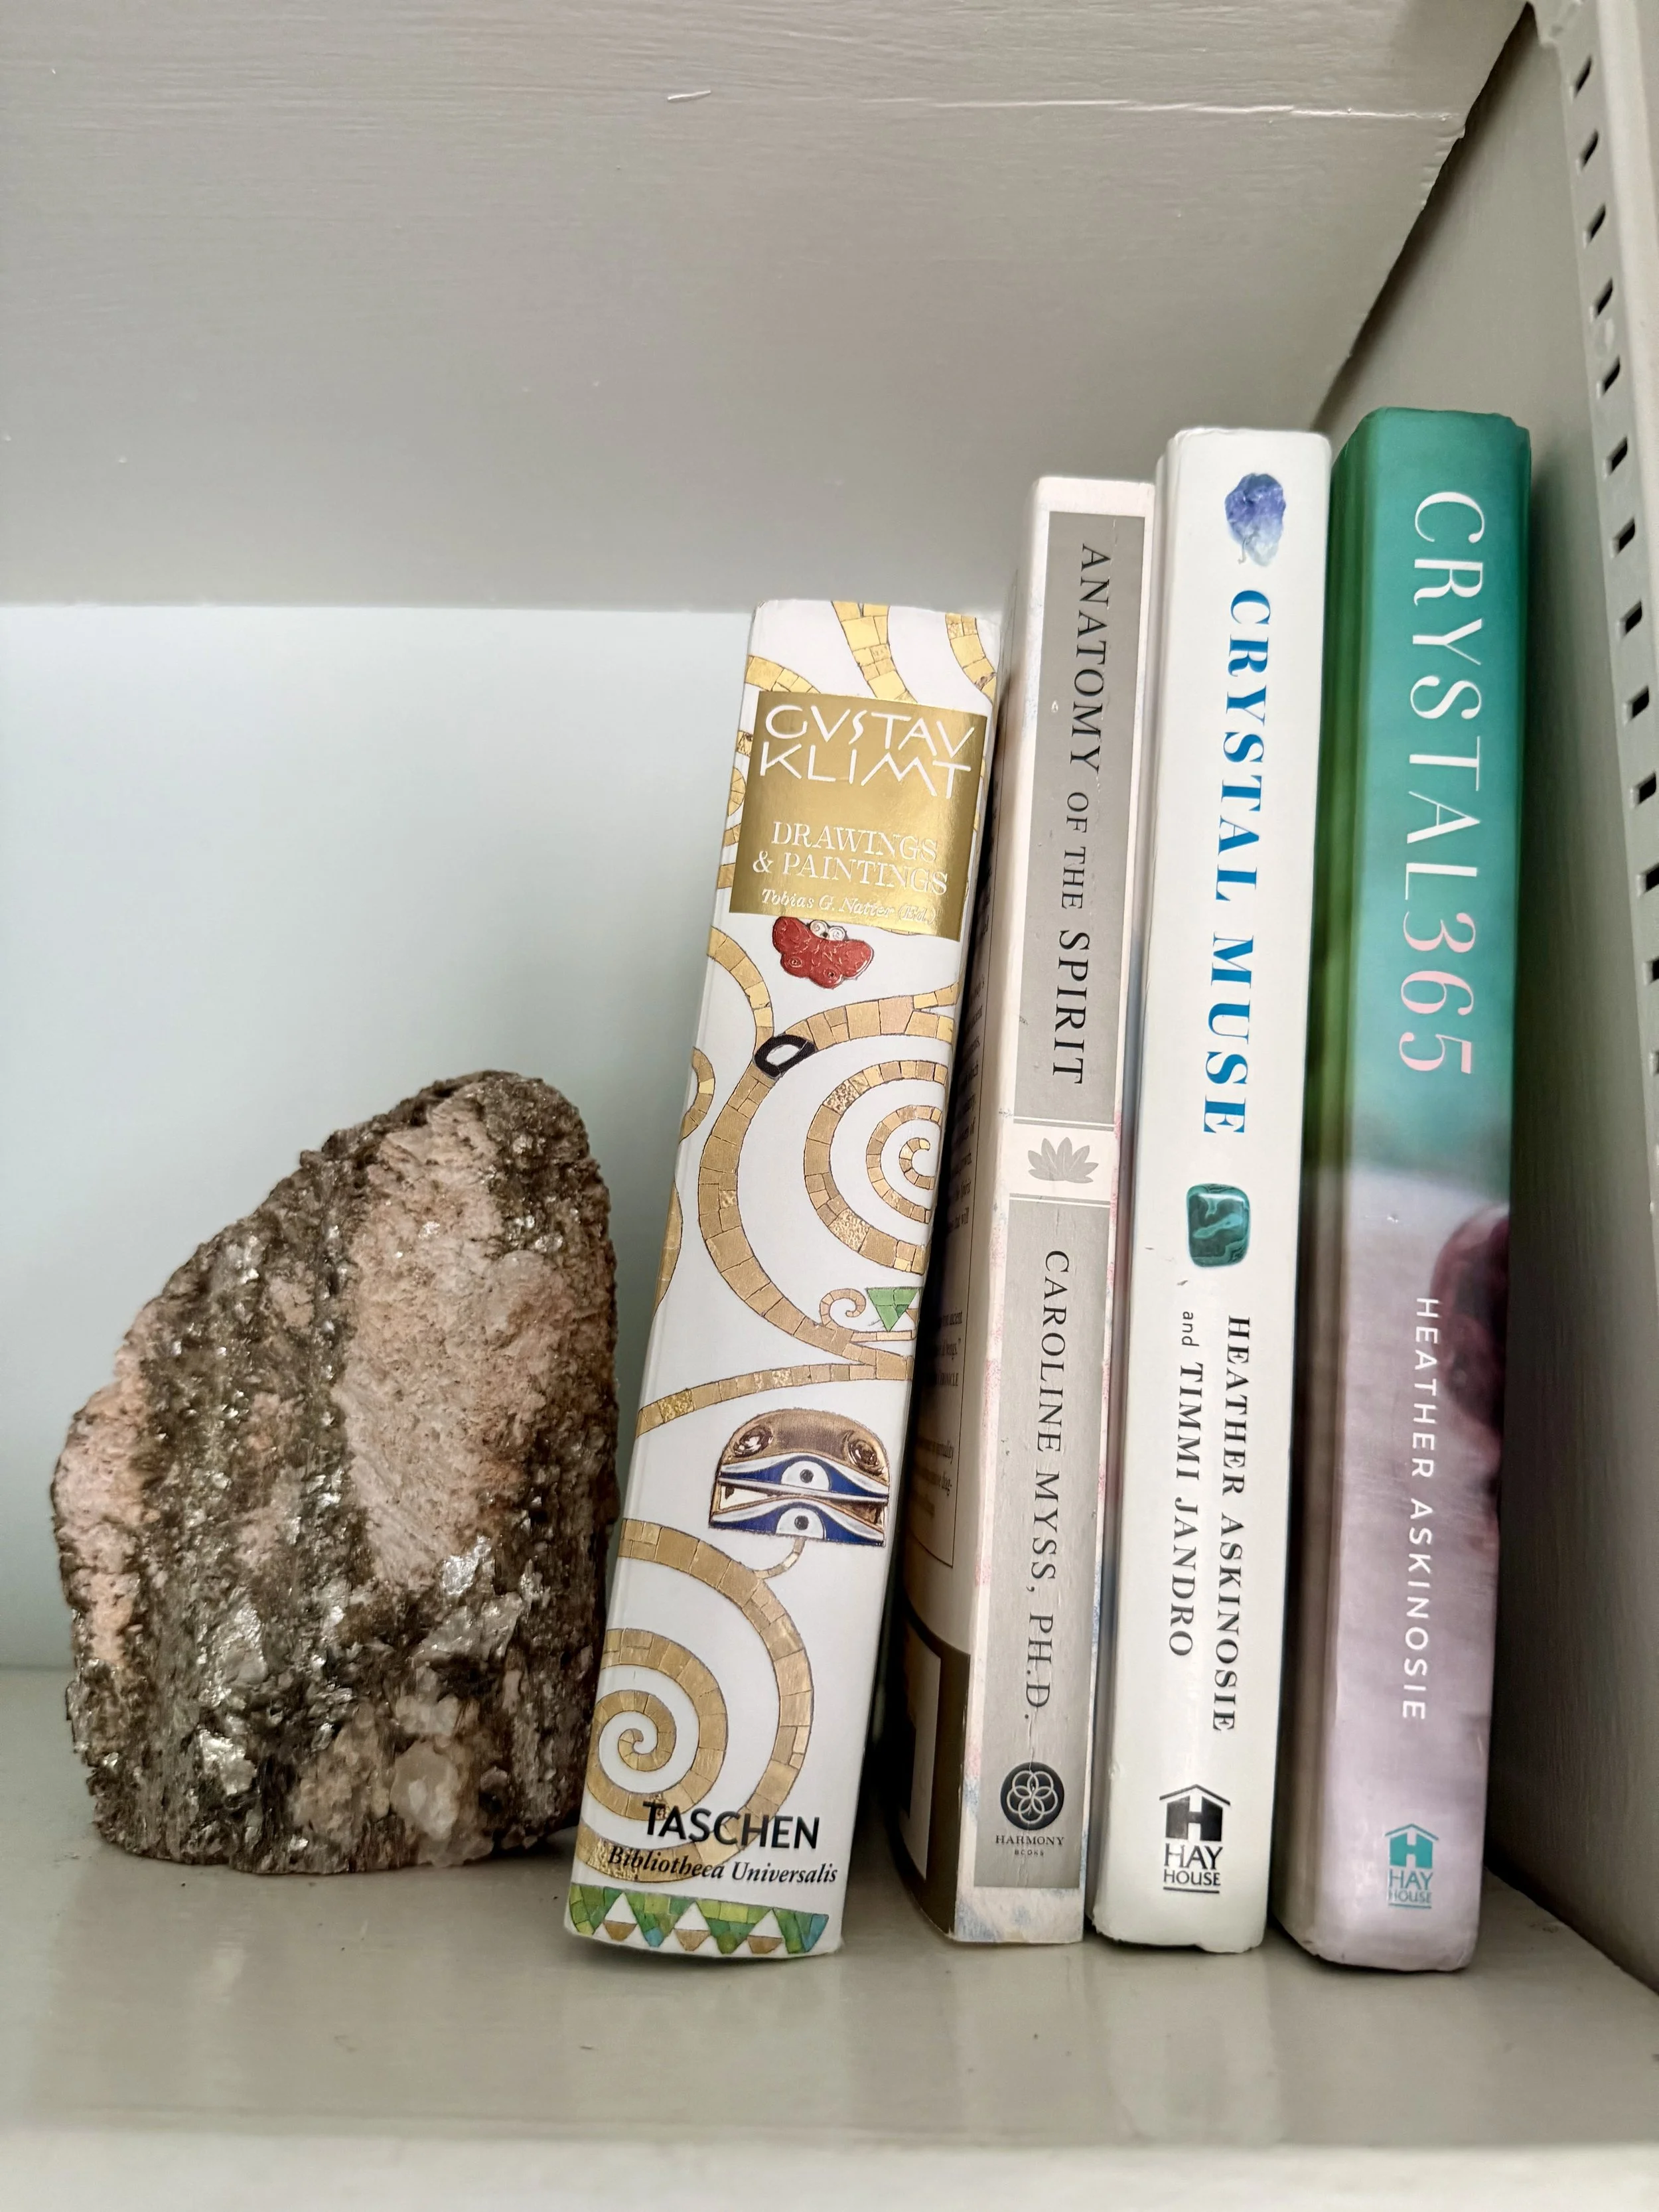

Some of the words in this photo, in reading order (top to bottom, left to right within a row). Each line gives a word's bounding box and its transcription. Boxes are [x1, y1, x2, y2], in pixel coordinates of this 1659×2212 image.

[1070, 543, 1112, 774] ANATOMY
[760, 741, 971, 799] KLIMT
[1215, 589, 1271, 902] CRYSTAL
[772, 821, 938, 862] DRAWINGS
[1066, 791, 1090, 834] OF
[753, 850, 773, 873] &
[782, 852, 948, 895] PAINTINGS
[1061, 846, 1086, 910] THE
[762, 888, 814, 909] Tobias
[819, 894, 835, 913] G.
[838, 897, 896, 919] Natter
[1052, 930, 1090, 1085] SPIRIT
[1203, 932, 1254, 1134] MUSE
[1037, 1250, 1070, 1452] CAROLINE
[1181, 1311, 1200, 1347] and
[1222, 1315, 1250, 1496] HEATHER
[1411, 1297, 1439, 1479] HEATHER
[1176, 1362, 1204, 1481] TIMMI
[1026, 1470, 1060, 1593] MYSS,
[1169, 1497, 1198, 1656] JANDRO
[1212, 1511, 1244, 1732] ASKINOSIE
[1402, 1498, 1434, 1720] ASKINOSIE
[642, 1801, 820, 1850] TASCHEN
[995, 1834, 1065, 1846] HARMONY
[609, 1845, 724, 1880] Bibliotheca
[731, 1862, 838, 1883] Universalis
[1163, 1868, 1222, 1886] HOUSE
[1164, 1843, 1223, 1870] HAY
[1389, 1869, 1433, 1890] HAY
[1388, 1889, 1433, 1904] HOUSE
